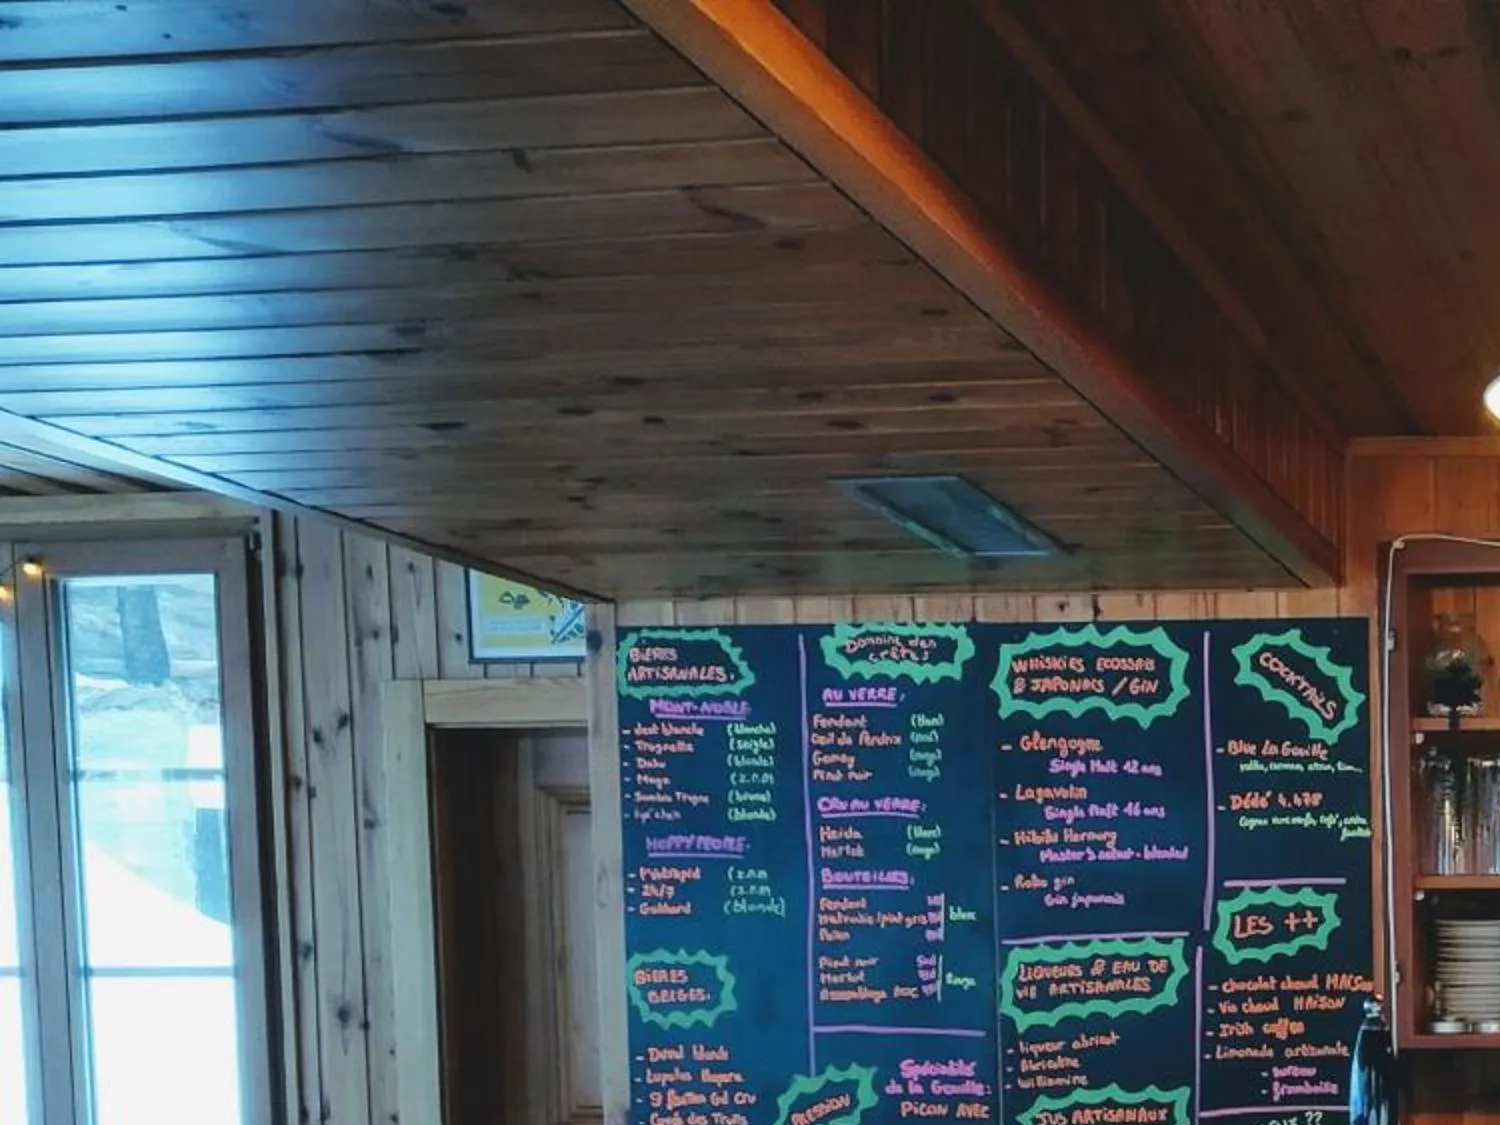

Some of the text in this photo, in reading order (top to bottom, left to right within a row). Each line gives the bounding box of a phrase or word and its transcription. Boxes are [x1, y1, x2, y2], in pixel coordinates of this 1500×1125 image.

[823, 687, 844, 702] AU
[1227, 739, 1257, 756] Blue
[1122, 759, 1140, 774] 12
[1122, 801, 1141, 817] 16
[1233, 909, 1320, 939] LES ++
[1111, 960, 1141, 975] EAU
[1147, 958, 1169, 975] DE
[955, 1102, 991, 1119] AVEC
